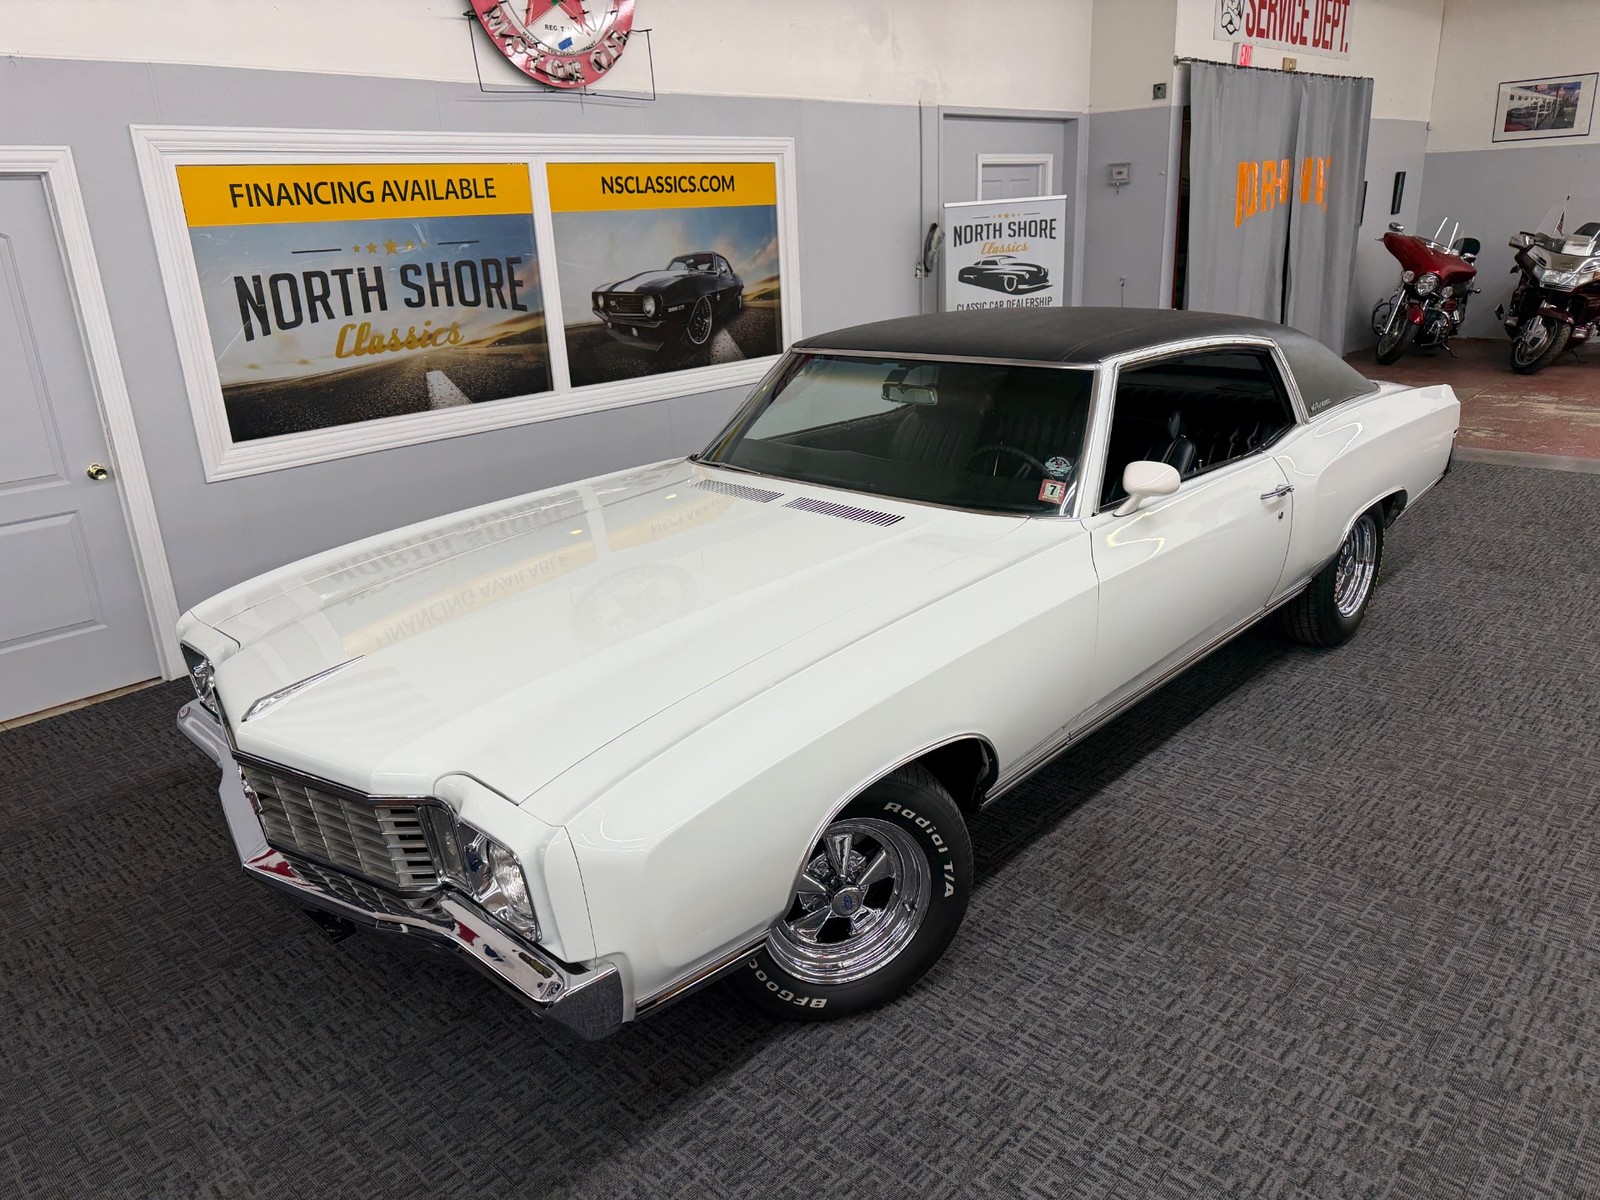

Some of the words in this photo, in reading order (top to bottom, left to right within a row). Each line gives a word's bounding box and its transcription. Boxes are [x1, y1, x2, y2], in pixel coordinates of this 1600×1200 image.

[545, 23, 561, 33] REG.
[1245, 0, 1309, 46] SERVICE
[1312, 0, 1351, 53] DEPT.
[229, 179, 375, 208] FINANCING
[381, 177, 497, 203] AVAILABLE
[601, 175, 736, 194] NSCLASSICS.COM
[953, 222, 1002, 247] NORTH
[1008, 218, 1056, 239] SHORE
[980, 240, 1030, 255] Classics
[233, 265, 388, 342] NORTH
[399, 256, 528, 312] SHORE
[956, 301, 987, 311] CLASSIC
[989, 300, 1004, 309] CAR
[1006, 296, 1053, 308] DEALERSHIP
[335, 320, 465, 359] Classics
[1050, 484, 1057, 496] 7
[883, 801, 949, 853] Radial
[943, 860, 955, 898] T/A
